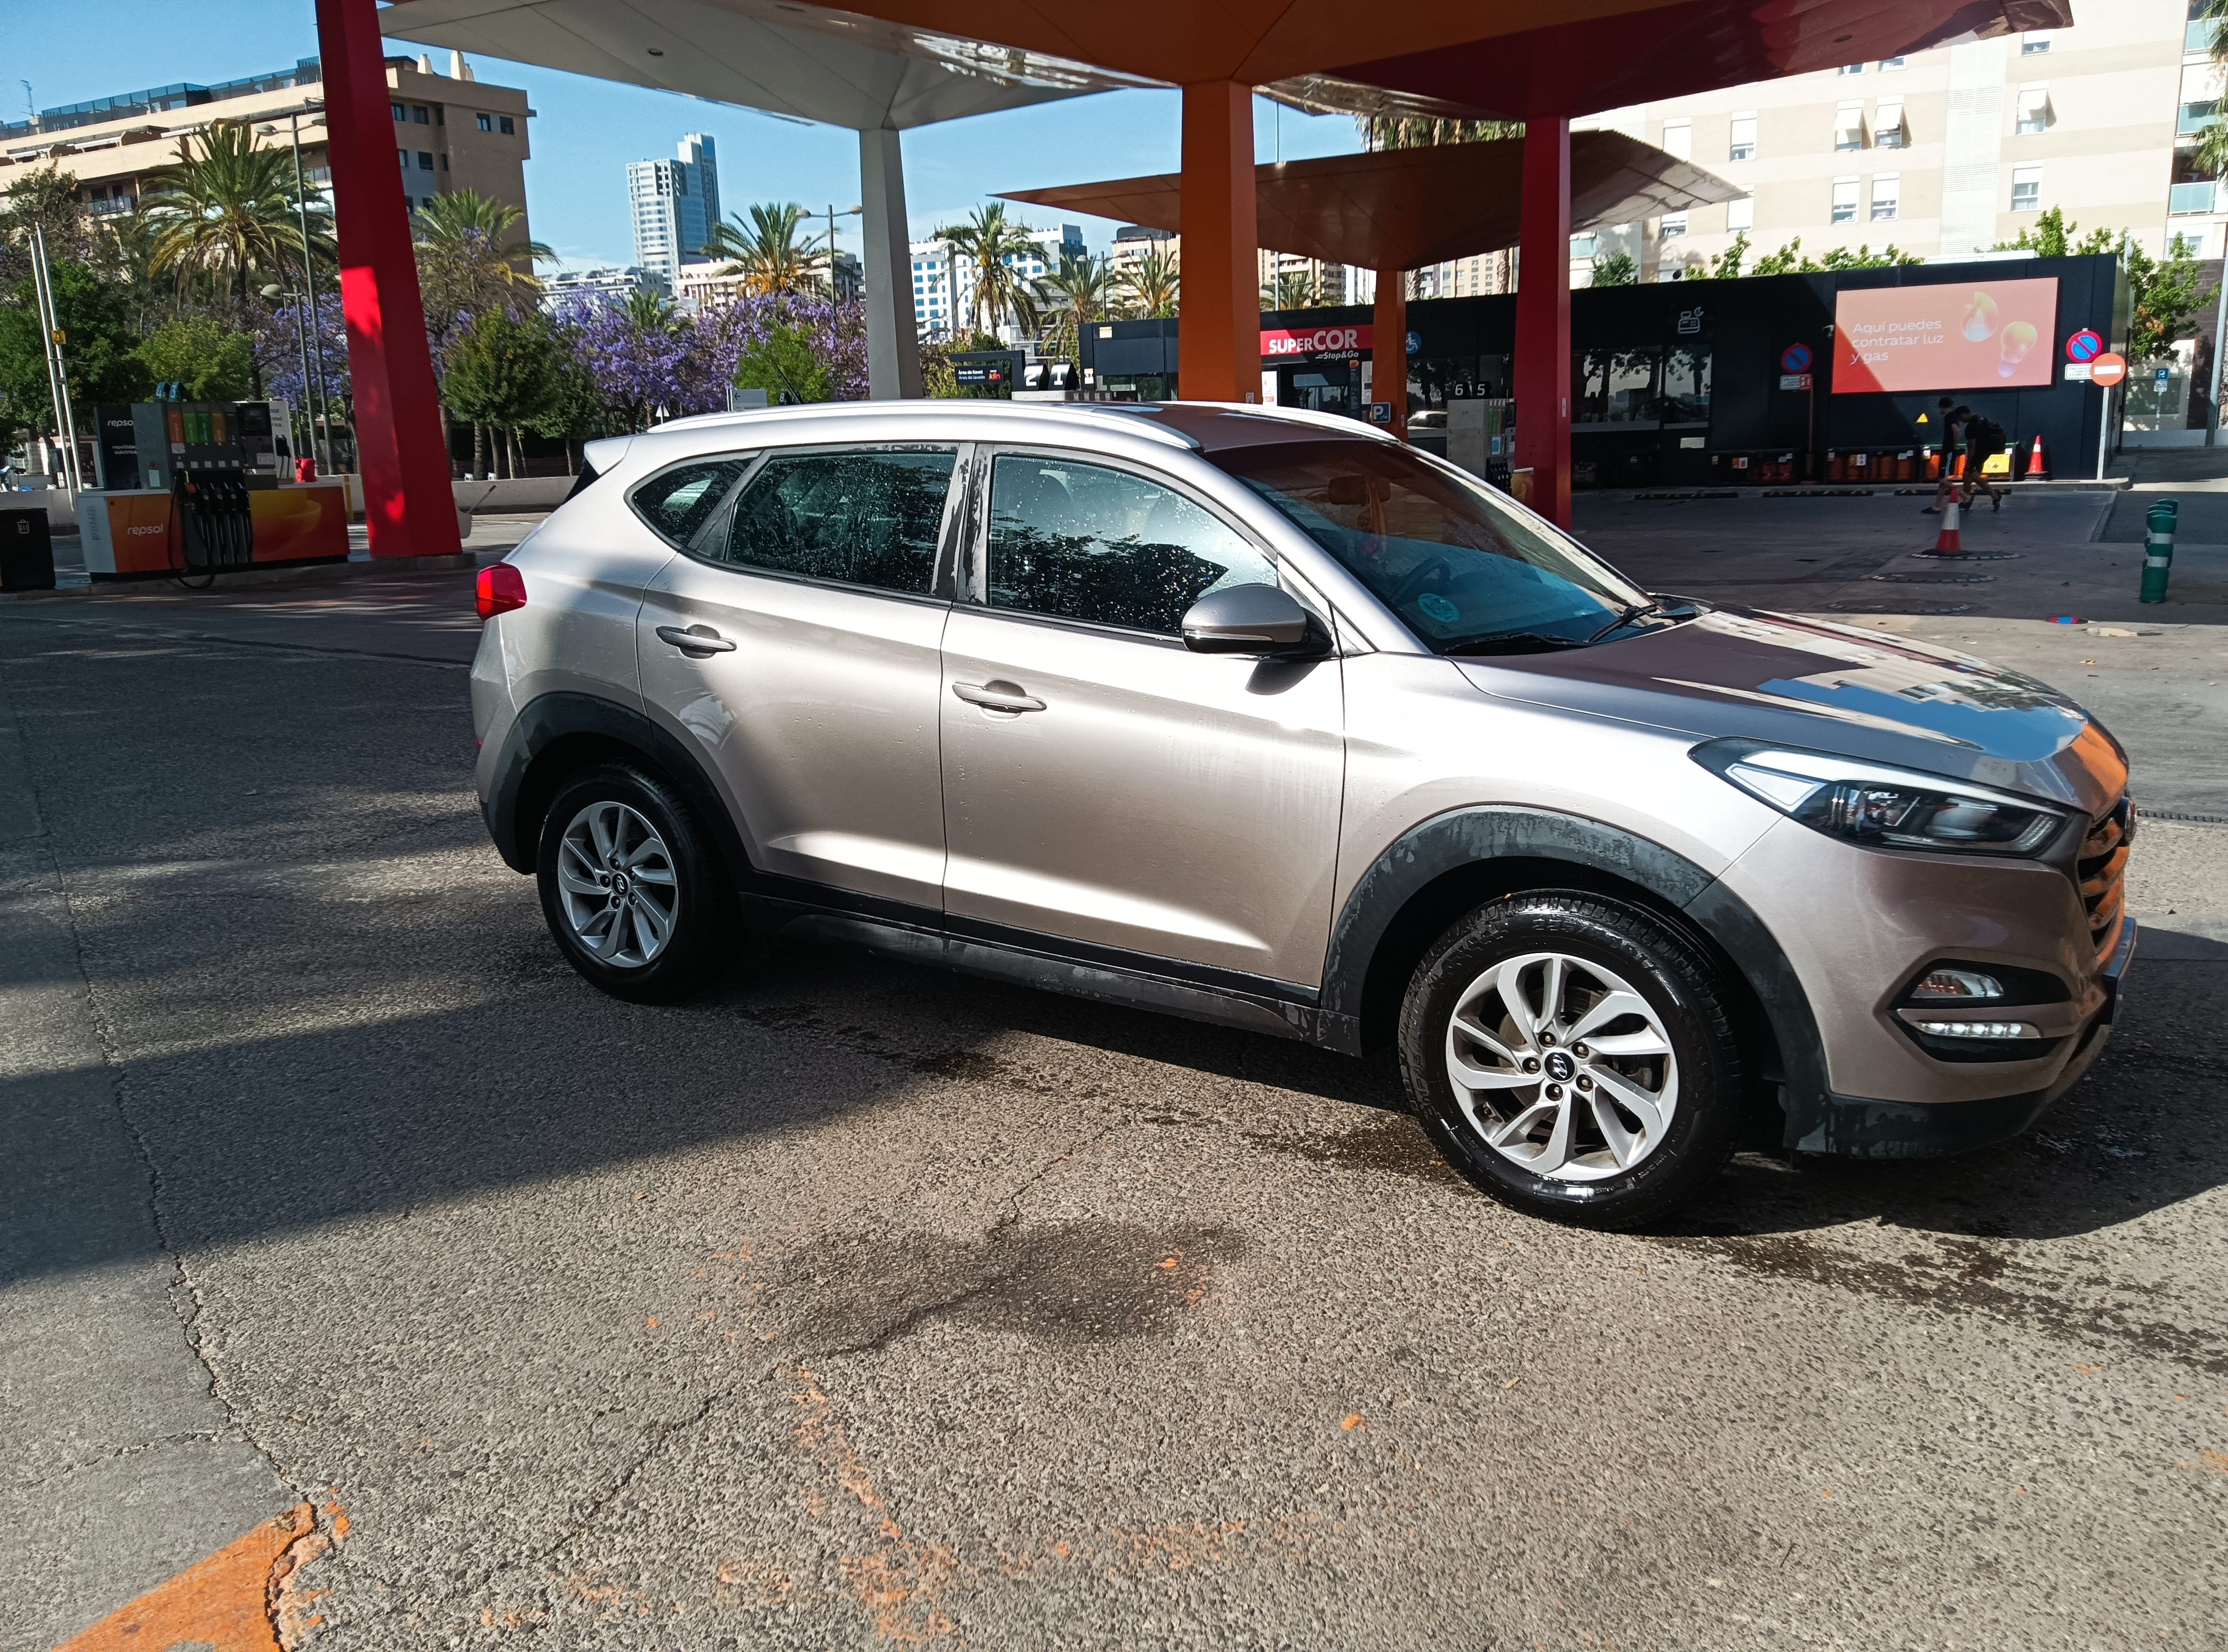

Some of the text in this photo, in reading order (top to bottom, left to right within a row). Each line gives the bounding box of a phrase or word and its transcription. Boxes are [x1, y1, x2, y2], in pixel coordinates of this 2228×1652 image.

[1853, 319, 1942, 335] Aquí puedes
[1269, 329, 1358, 354] SUPERCOR
[1852, 333, 1945, 348] contratar luz
[1323, 350, 1359, 361] Stop&Go
[1850, 352, 1889, 365] y gas
[1025, 372, 1037, 386] 2
[1053, 371, 1063, 385] 1
[2158, 370, 2166, 378] P
[156, 385, 162, 398] 4
[170, 384, 177, 398] 3
[1455, 384, 1463, 396] 6
[1477, 383, 1485, 396] 5
[779, 392, 785, 402] 8
[1373, 406, 1383, 419] P
[127, 523, 164, 536] repsol
